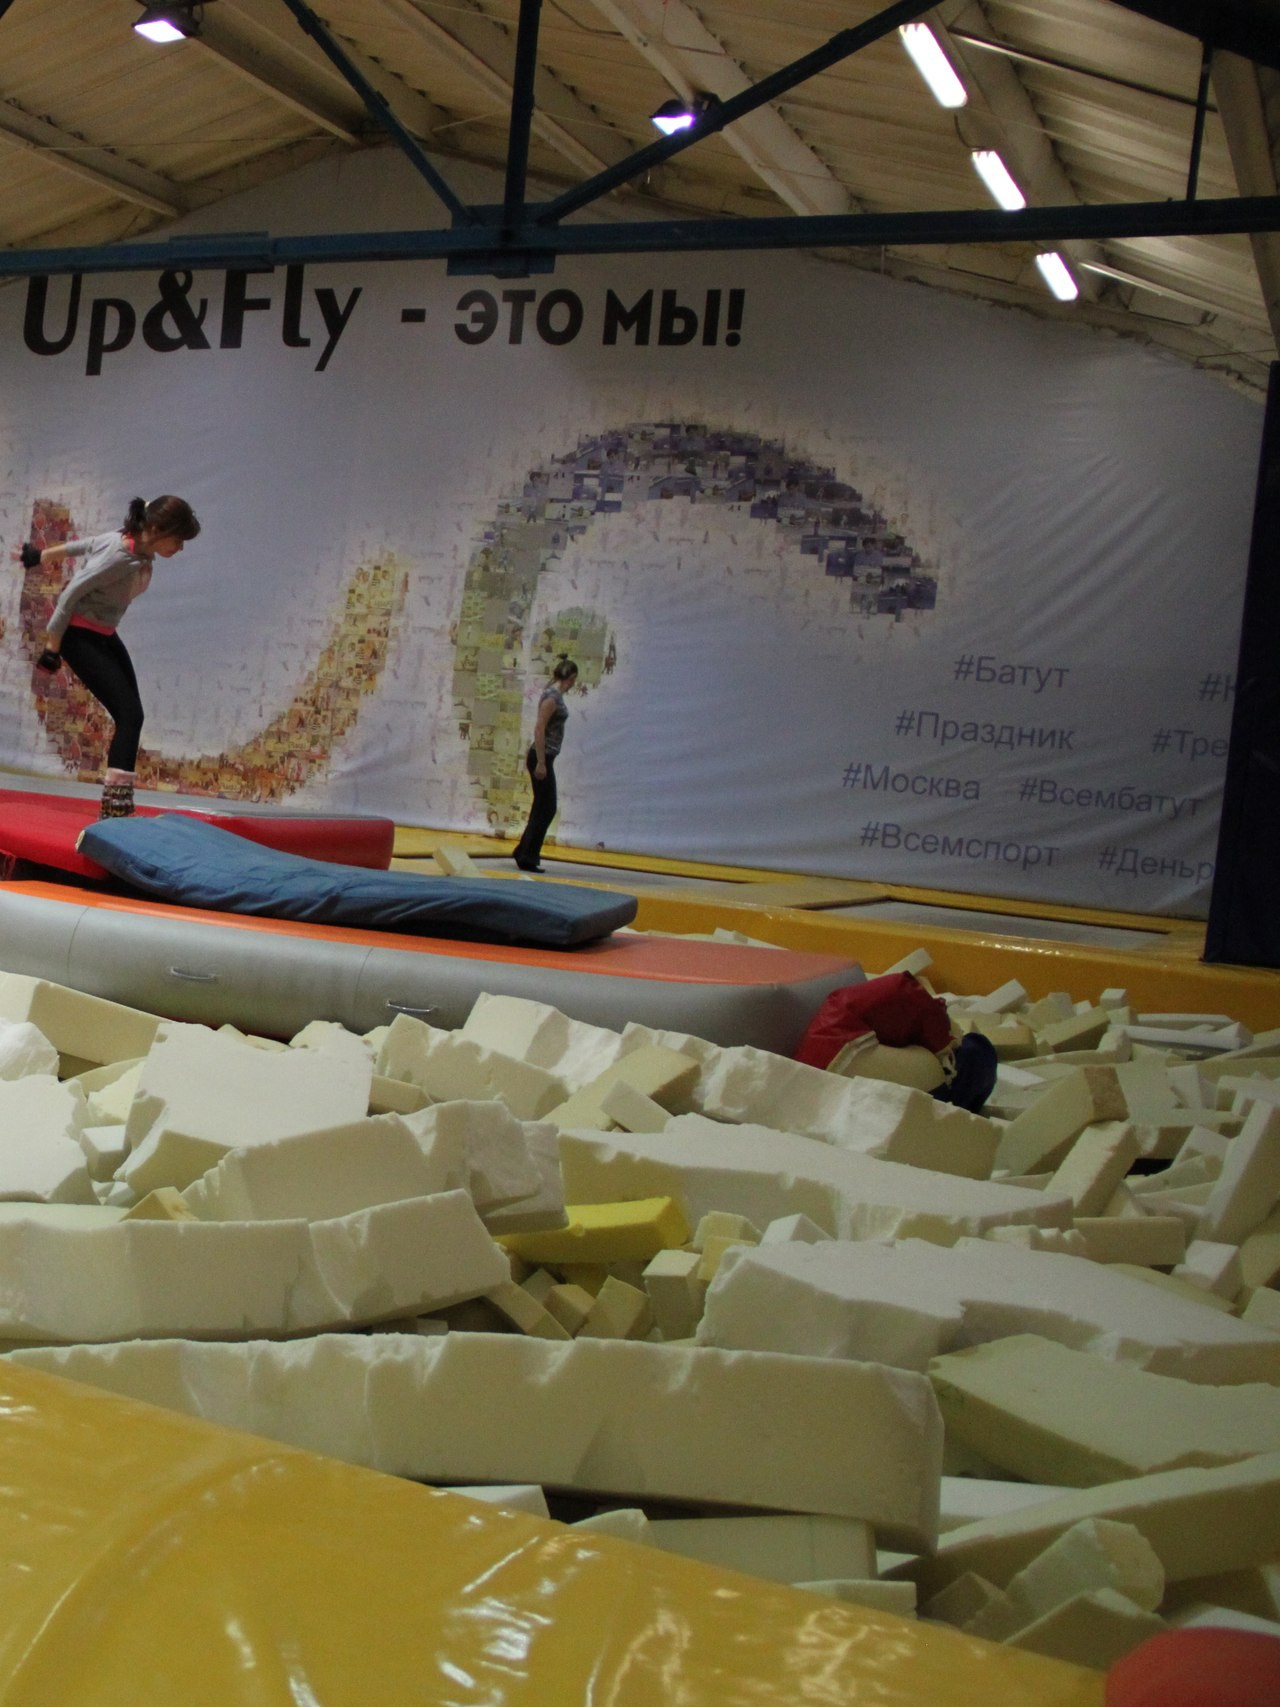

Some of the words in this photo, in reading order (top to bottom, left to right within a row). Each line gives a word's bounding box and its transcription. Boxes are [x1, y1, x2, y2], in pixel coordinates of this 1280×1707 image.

[23, 264, 363, 376] Up&Fly
[953, 654, 1070, 694] #Батут
[895, 709, 1075, 751] #Праздник
[842, 761, 981, 801] #Москва
[1019, 777, 1201, 821] #Всембатут
[859, 820, 1060, 871] #Всемспорт
